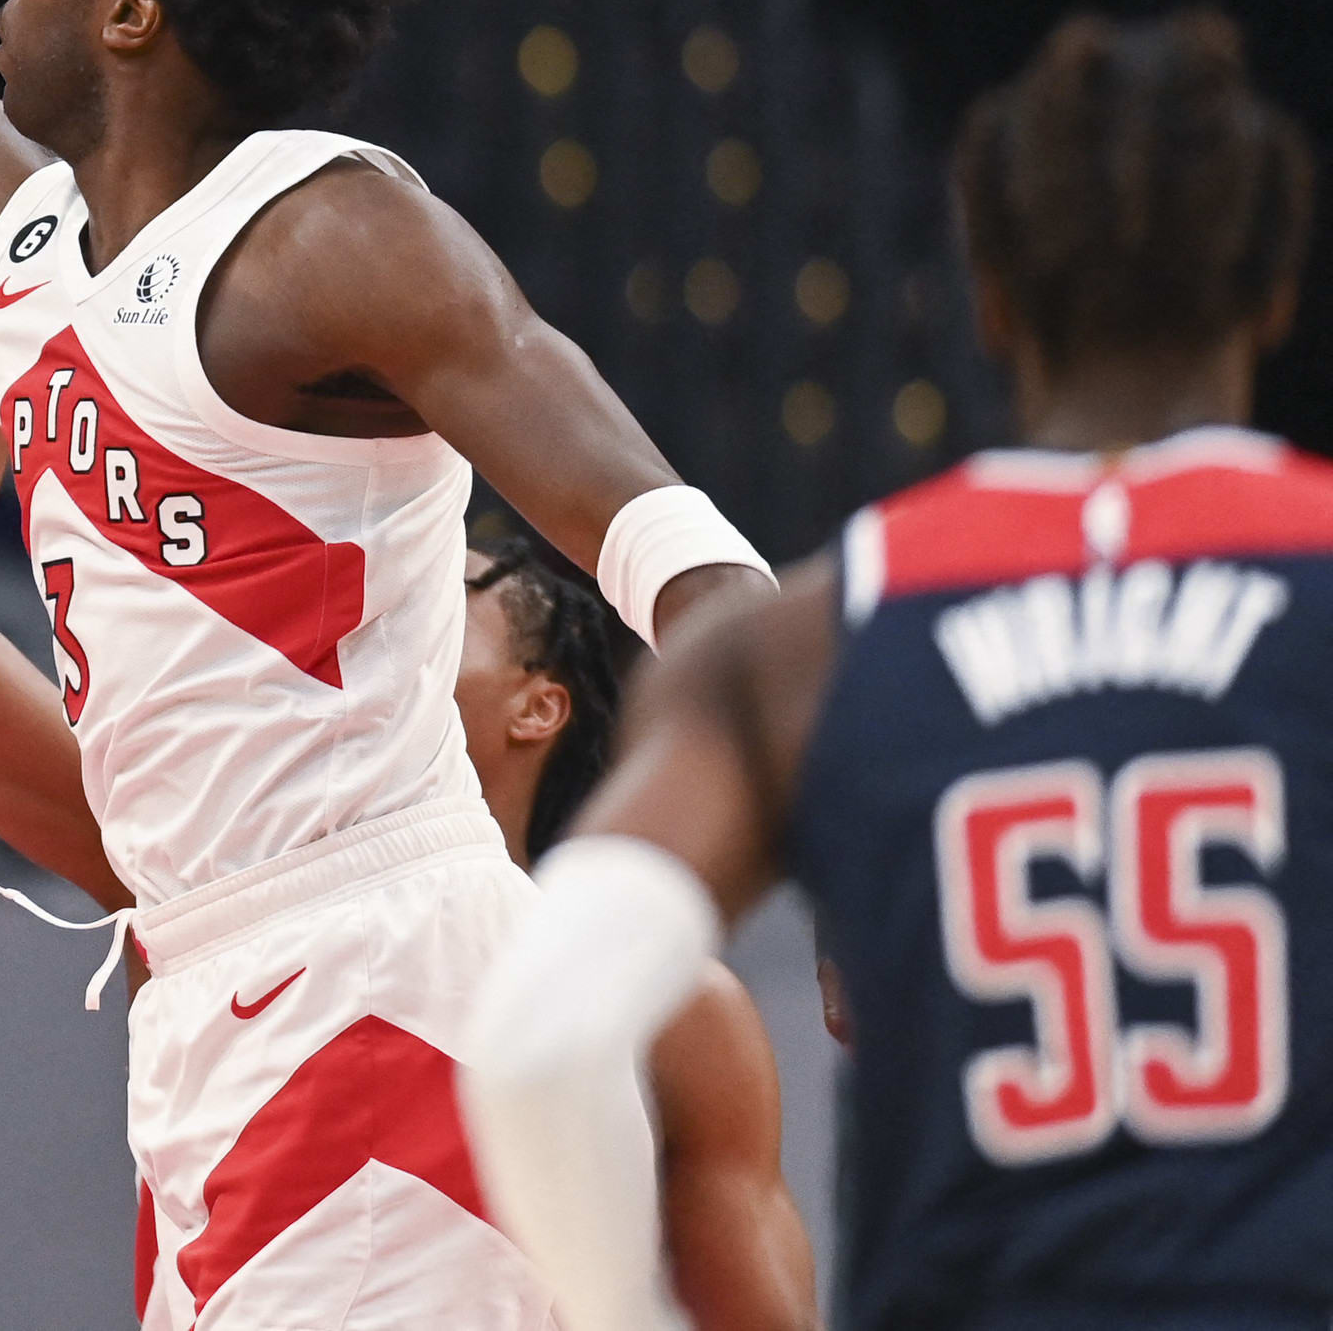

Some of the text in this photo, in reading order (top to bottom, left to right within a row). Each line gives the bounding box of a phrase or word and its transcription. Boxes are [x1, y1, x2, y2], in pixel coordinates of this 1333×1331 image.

[15, 221, 52, 258] 6
[113, 307, 169, 325] Sun Life
[931, 557, 1290, 726] WRIGHT
[934, 743, 1290, 1169] 55
